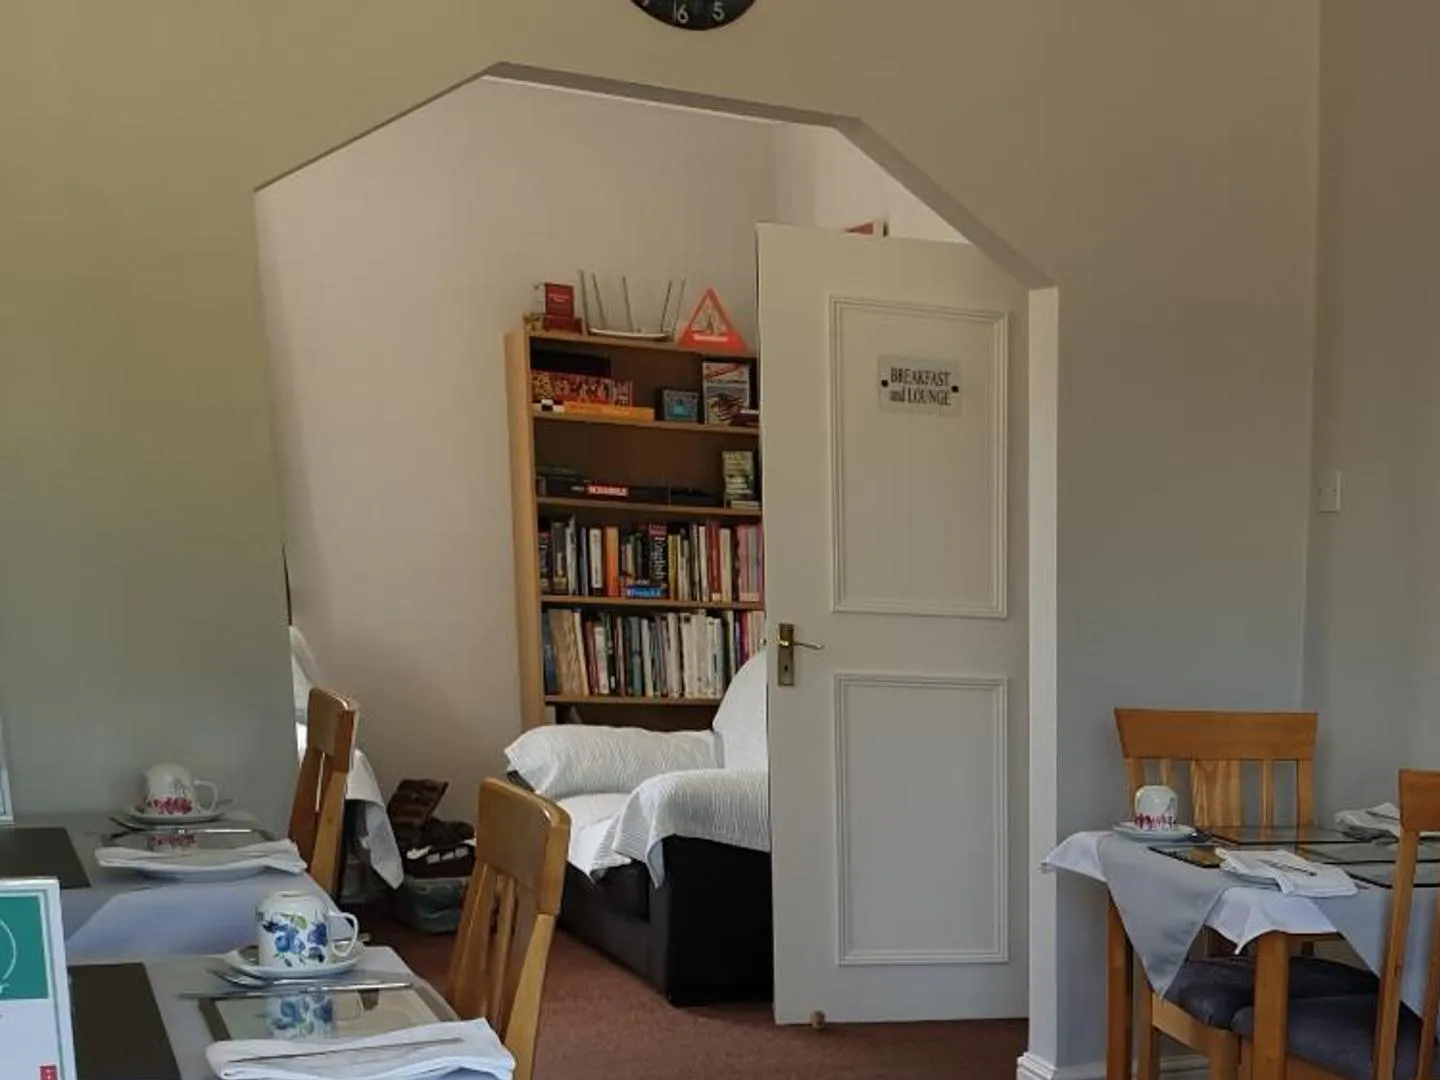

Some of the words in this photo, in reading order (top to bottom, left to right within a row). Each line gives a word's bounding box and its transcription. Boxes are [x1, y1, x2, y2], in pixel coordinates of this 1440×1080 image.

[712, 1, 725, 20] 5
[890, 367, 952, 388] BREAKFAST
[907, 387, 952, 406] LOUNGE
